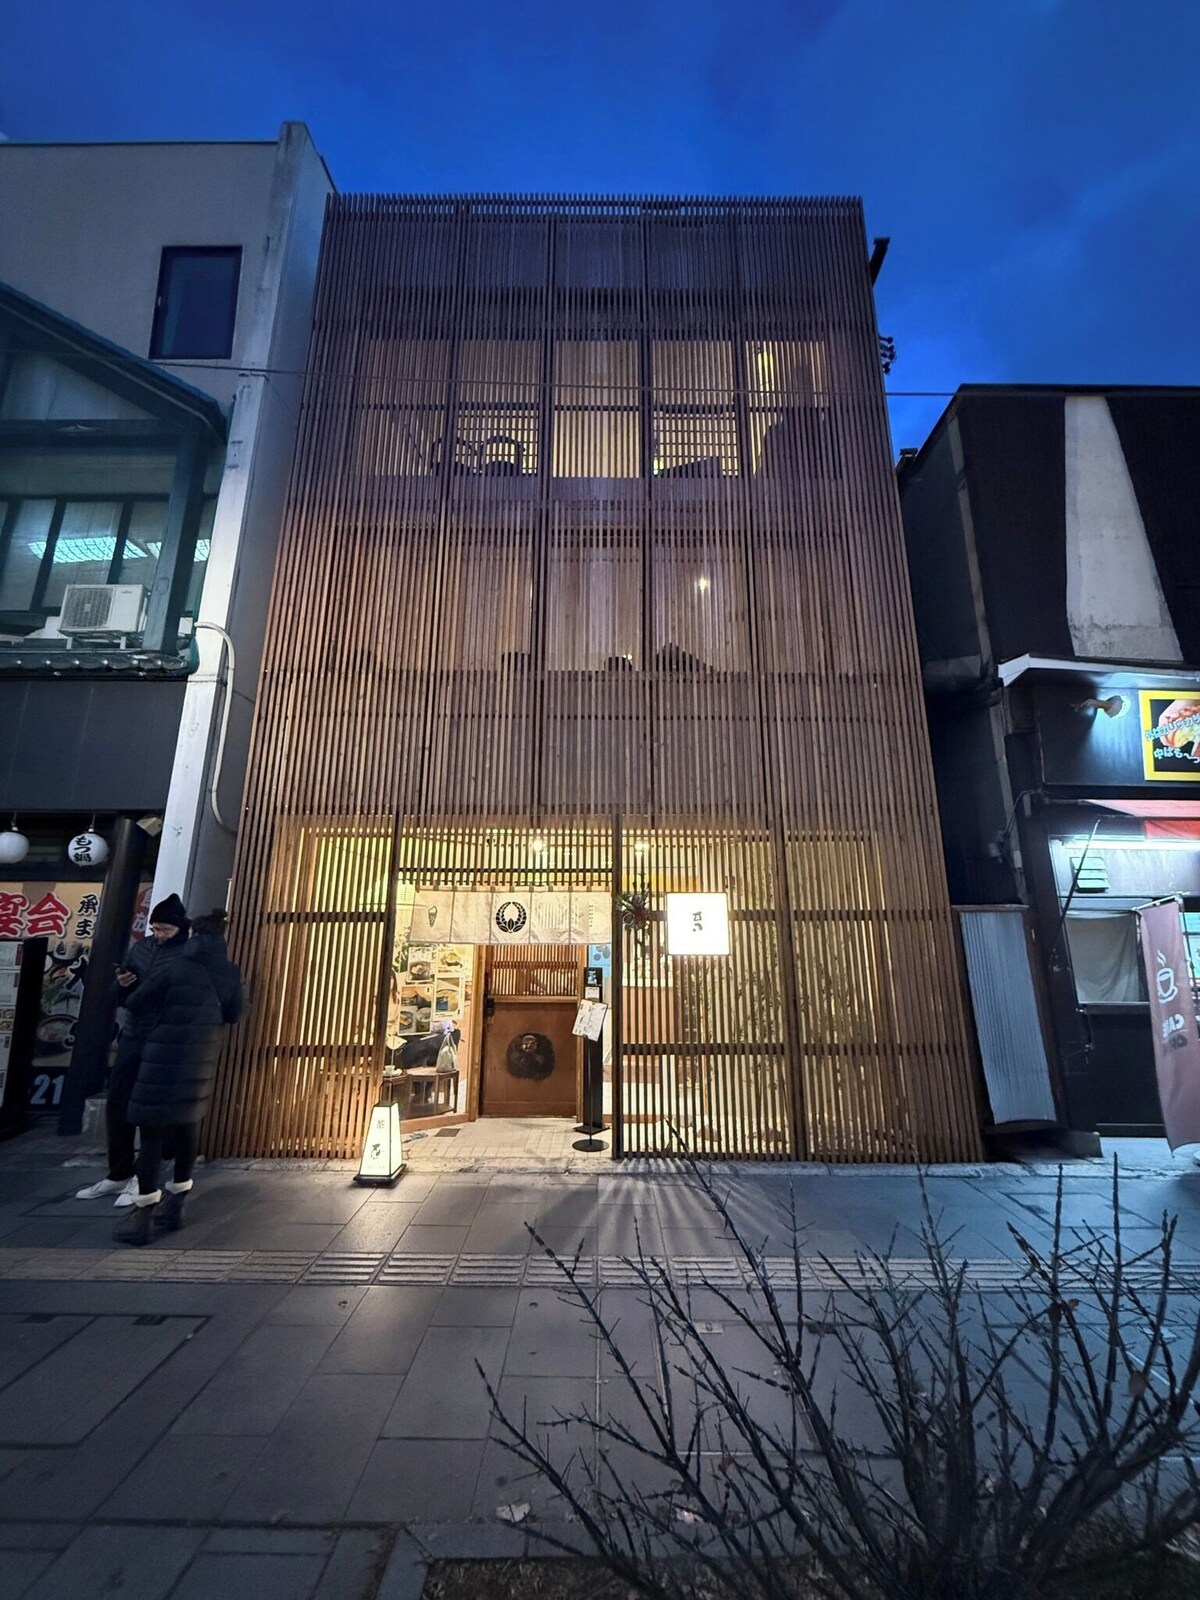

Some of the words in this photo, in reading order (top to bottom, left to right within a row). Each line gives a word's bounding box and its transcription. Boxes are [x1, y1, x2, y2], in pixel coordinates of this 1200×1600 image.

[73, 835, 93, 863] もつ鍋
[29, 1073, 65, 1106] 21
